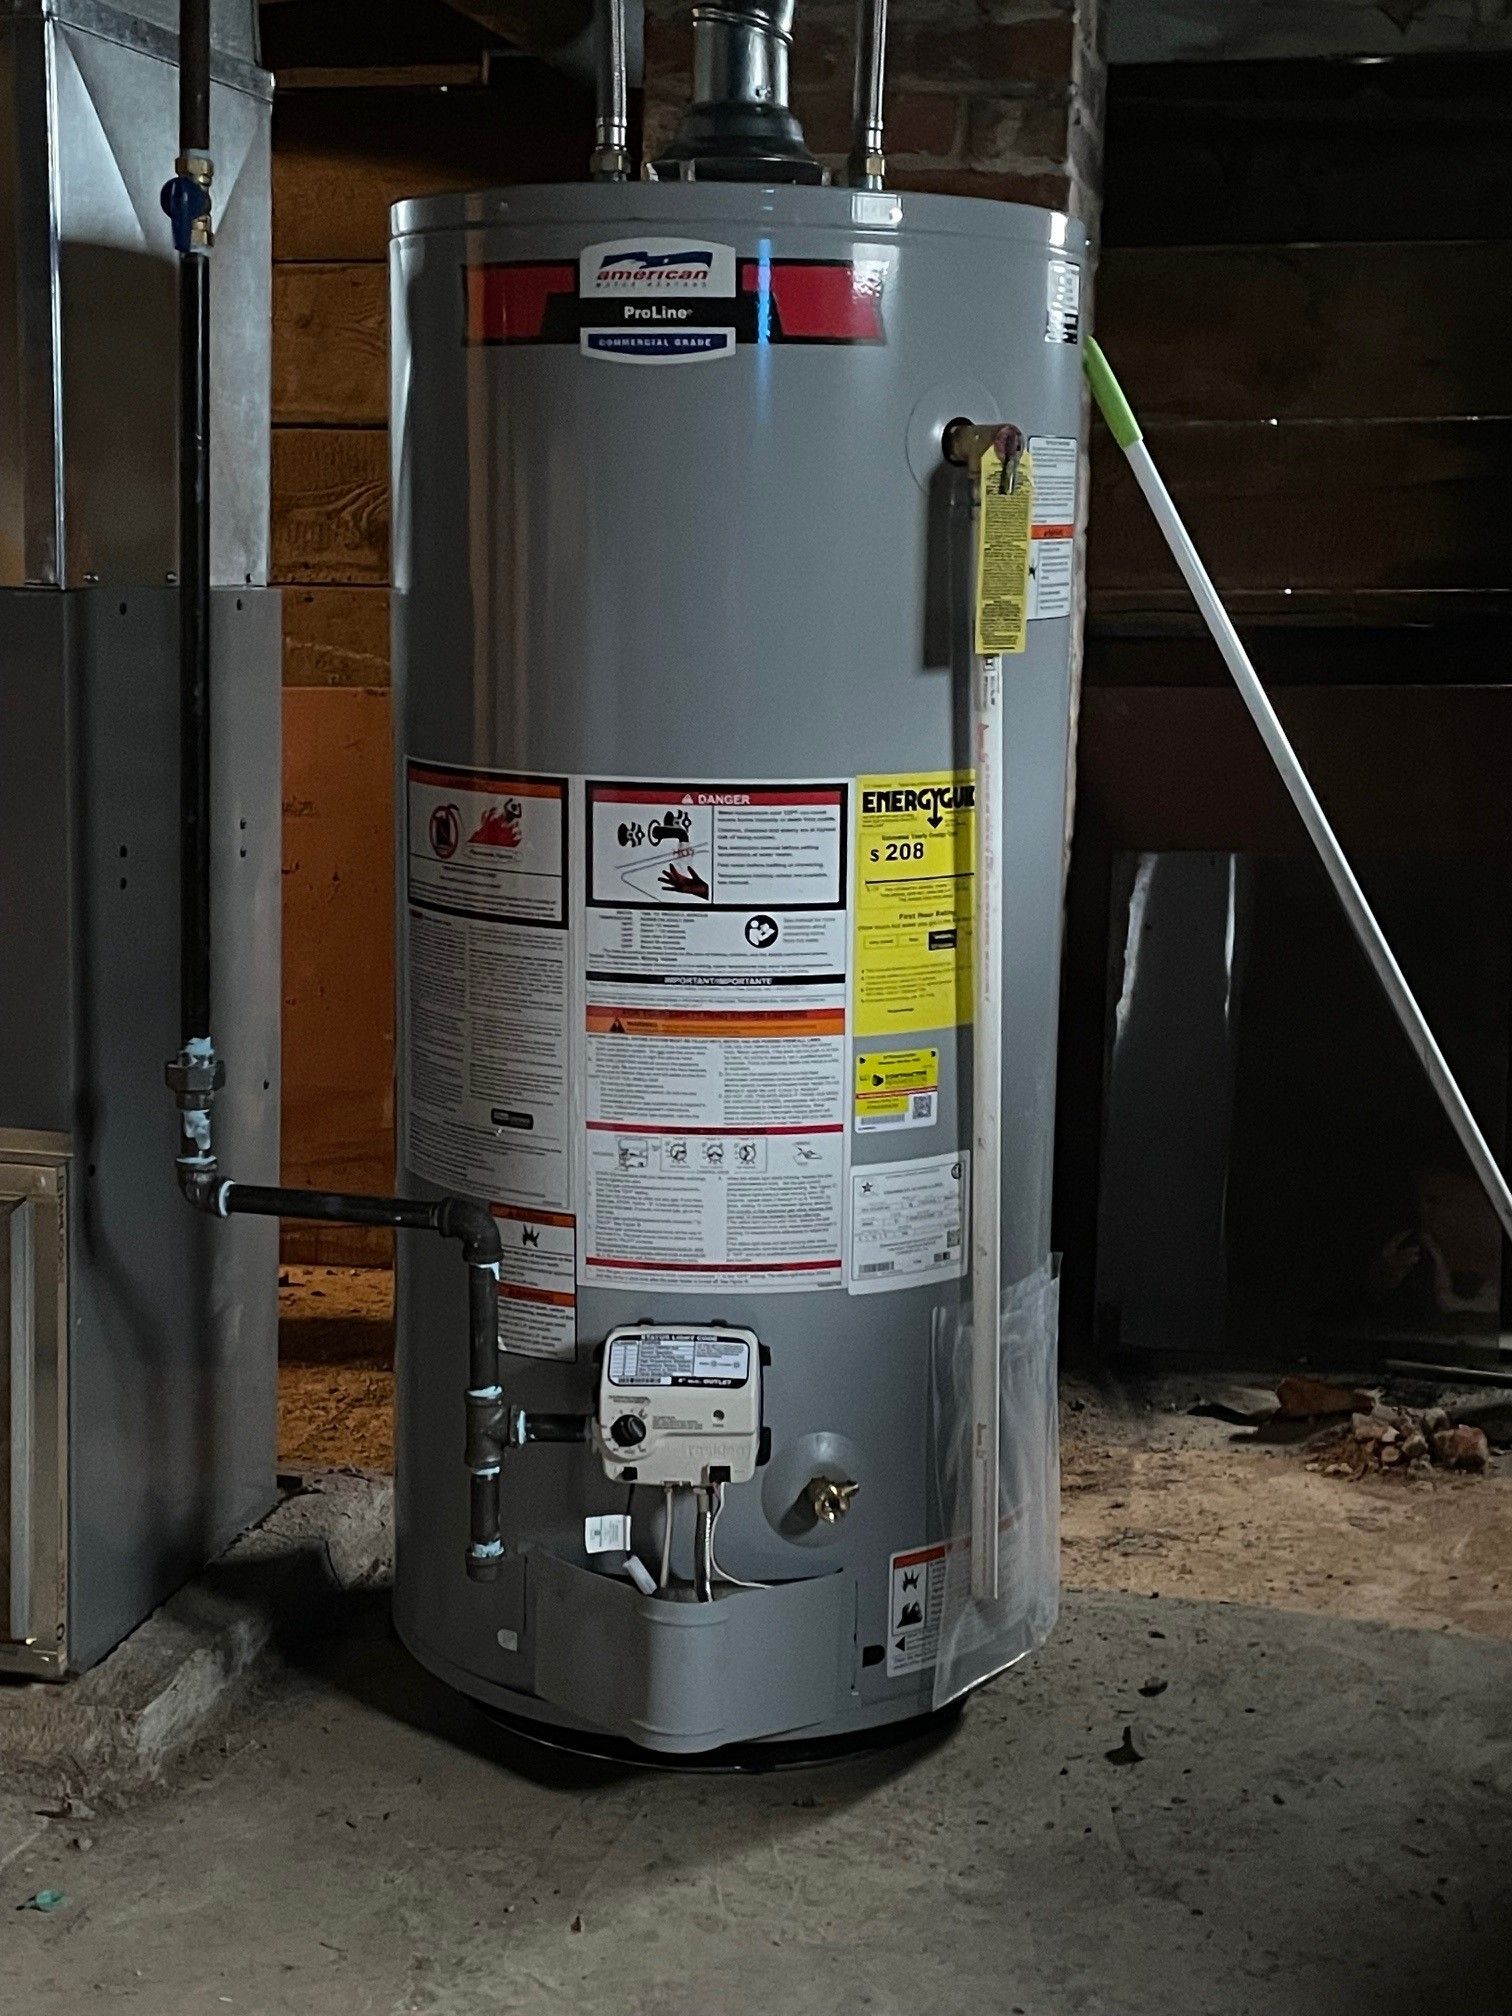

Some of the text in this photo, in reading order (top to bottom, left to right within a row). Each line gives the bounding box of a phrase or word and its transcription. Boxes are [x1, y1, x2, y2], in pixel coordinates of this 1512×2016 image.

[597, 269, 708, 281] american
[599, 338, 711, 347] COMMERCIAL GRADE
[698, 793, 751, 805] DANGER
[885, 842, 924, 861] 208
